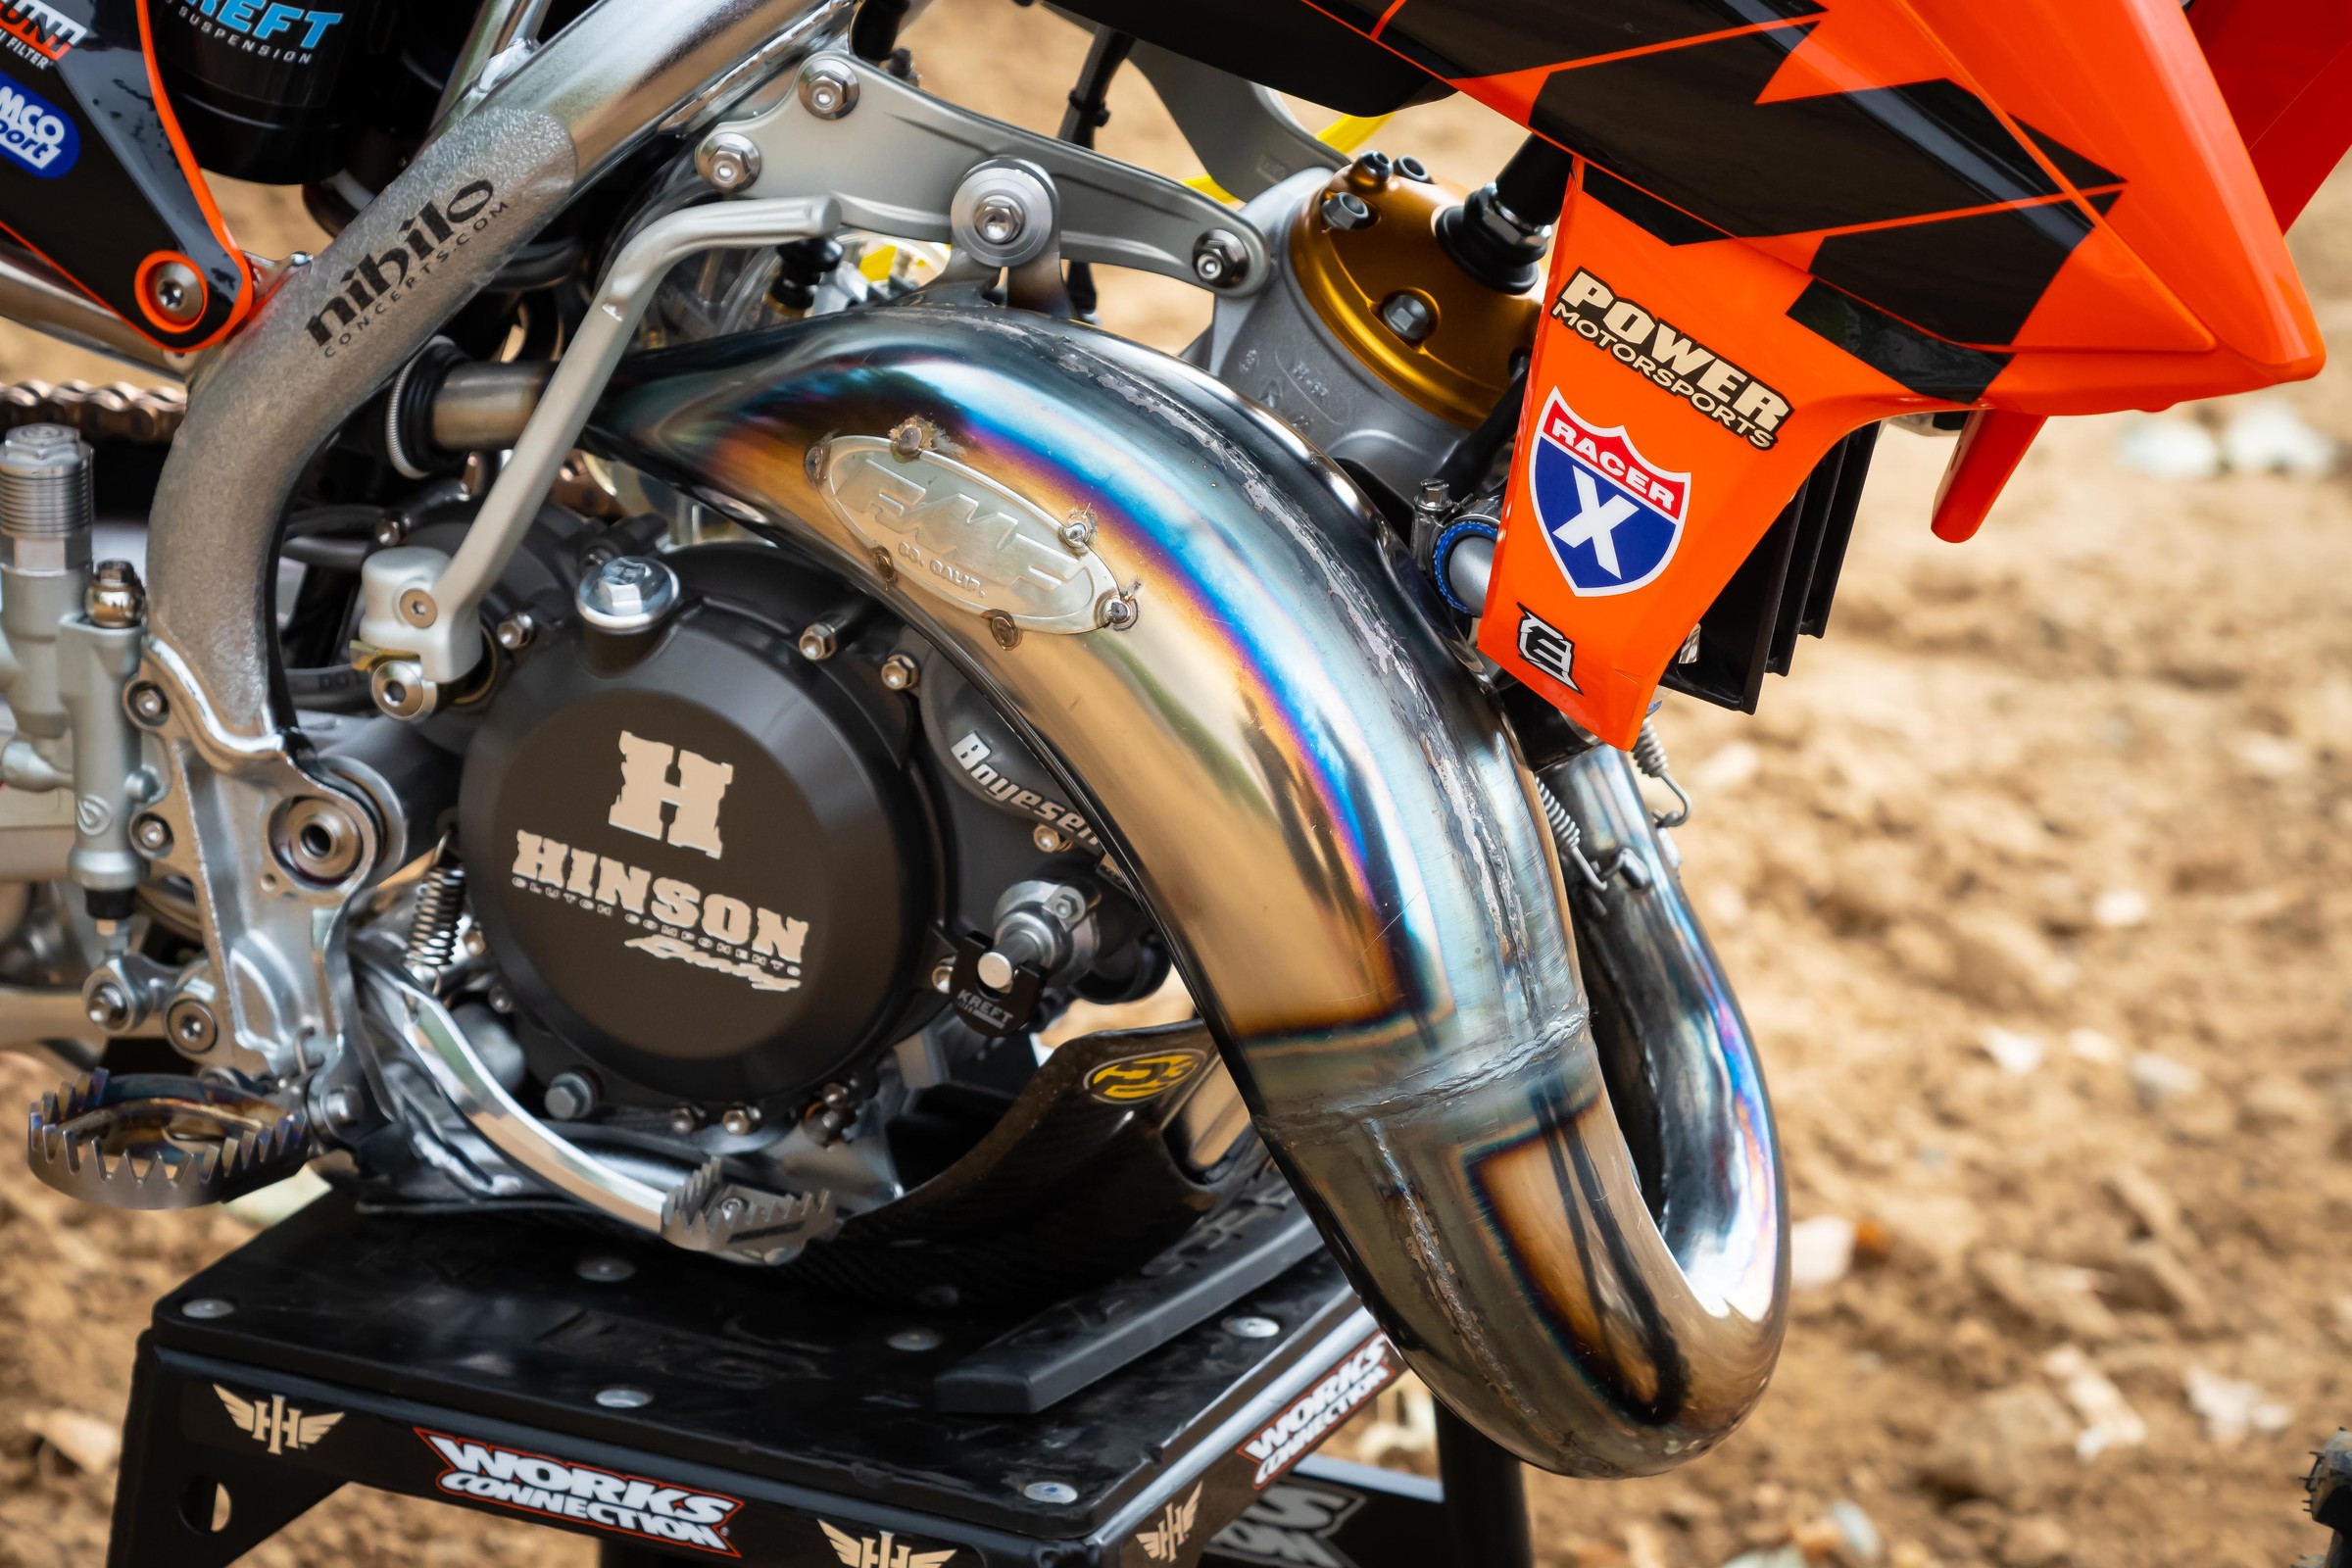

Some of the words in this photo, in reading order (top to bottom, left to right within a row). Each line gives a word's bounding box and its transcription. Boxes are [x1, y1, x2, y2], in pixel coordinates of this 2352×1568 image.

[6, 36, 50, 71] FILTER
[178, 5, 313, 65] SUSPENSION
[304, 179, 494, 347] nihilo
[323, 201, 509, 358] CONCEPTS.COM
[1551, 302, 1778, 449] MOTORSPORTS
[1560, 270, 1790, 432] POWER
[1551, 416, 1676, 511] RACER
[1551, 465, 1641, 580] X
[608, 730, 734, 860] H
[512, 829, 809, 963] HINSON
[956, 988, 1014, 1024] KREFT
[1244, 1330, 1387, 1460] WORKS
[1254, 1365, 1391, 1486] CONNECTION
[427, 1434, 735, 1525] WORKS
[440, 1470, 728, 1551] CONNECTION
